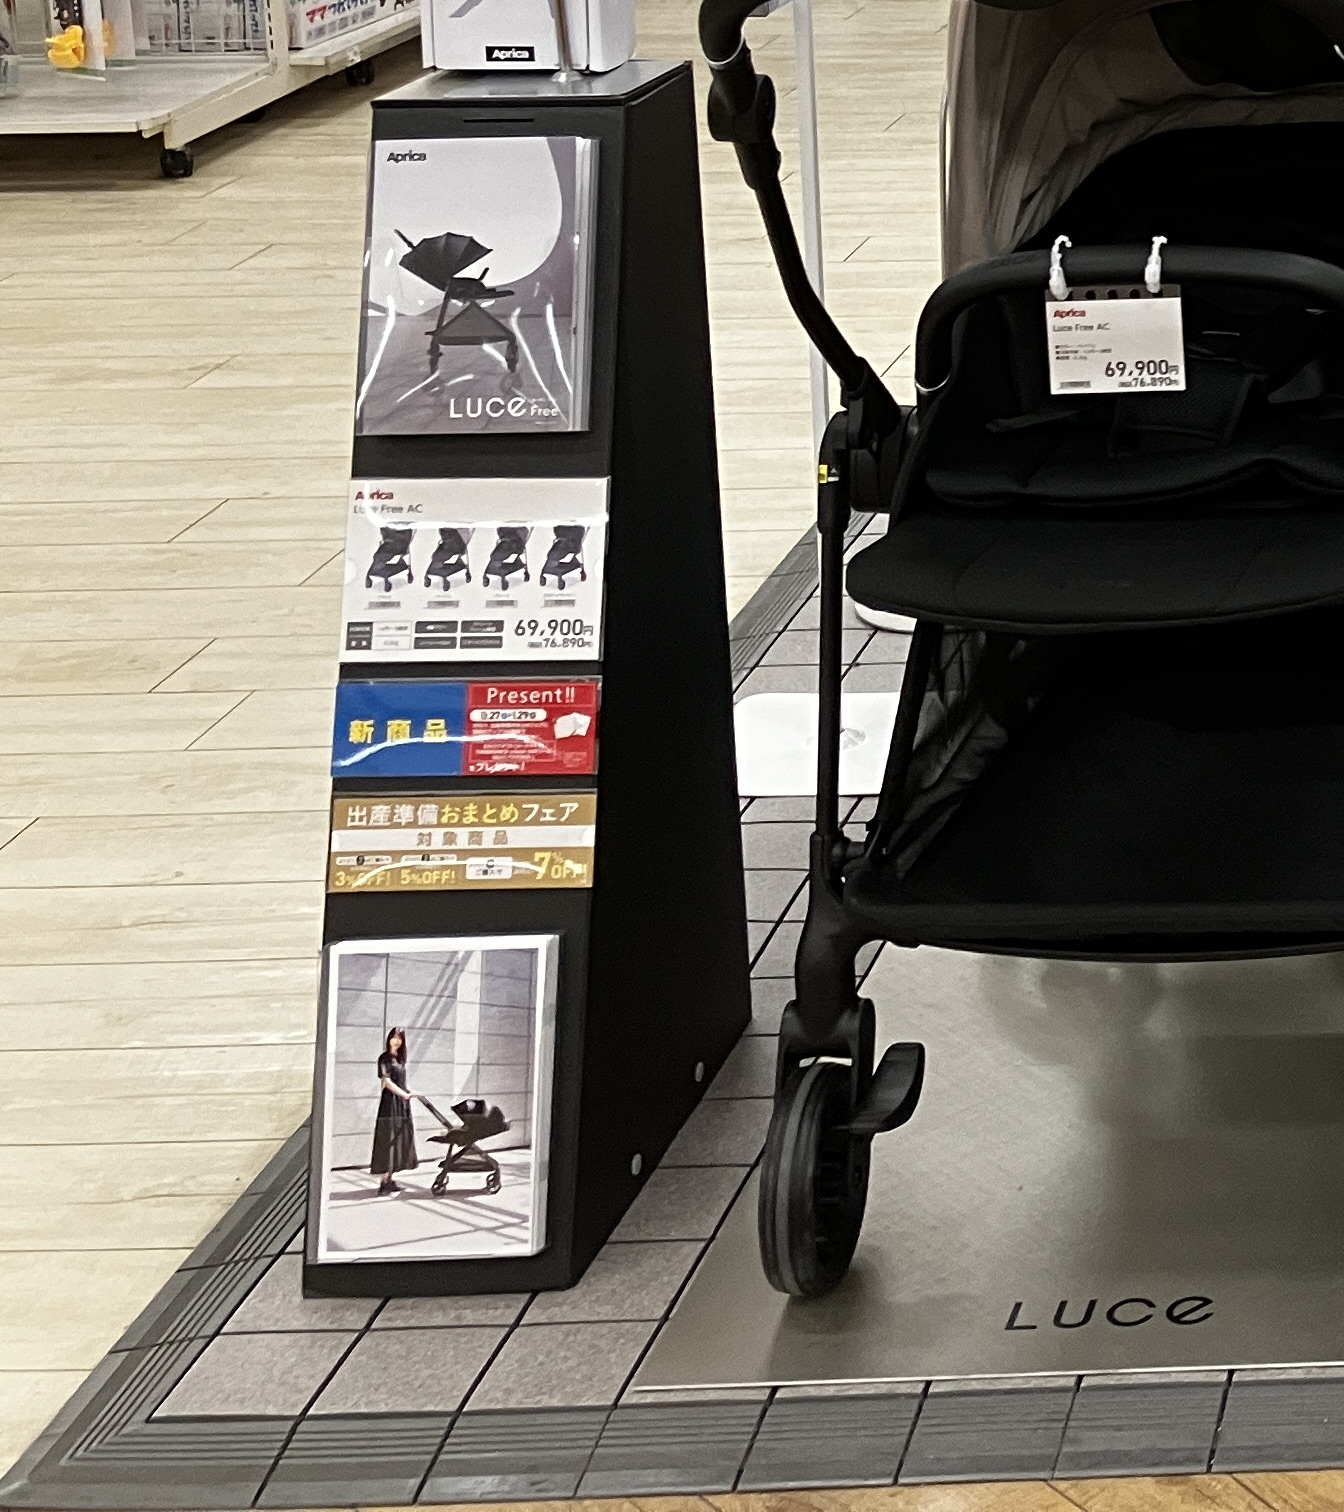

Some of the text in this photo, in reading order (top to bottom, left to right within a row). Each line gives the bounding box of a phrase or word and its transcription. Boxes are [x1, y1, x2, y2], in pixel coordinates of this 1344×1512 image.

[492, 48, 529, 61] Aprica
[386, 150, 427, 164] Aprica
[1105, 359, 1179, 378] 69,900円
[355, 489, 394, 501] Arica
[514, 618, 594, 637] 69,900円
[487, 686, 575, 704] Present!!
[348, 718, 448, 744] 新商品
[347, 802, 579, 827] 出産準備おまとめフェア
